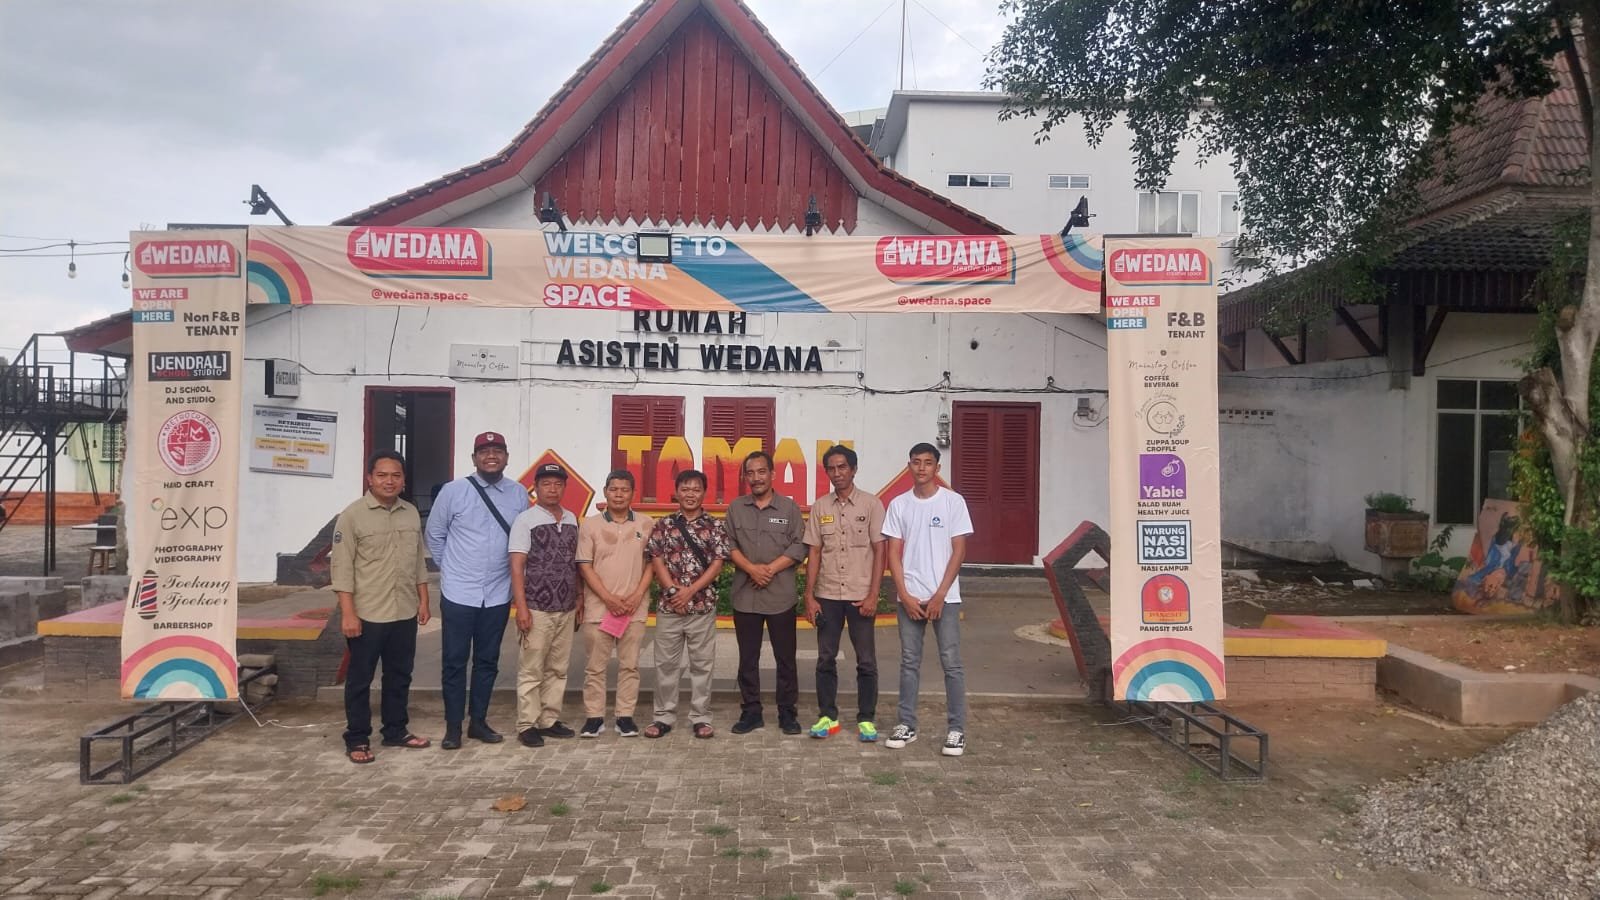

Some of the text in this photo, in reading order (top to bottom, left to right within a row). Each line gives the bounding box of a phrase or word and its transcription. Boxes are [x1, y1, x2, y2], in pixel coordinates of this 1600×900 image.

[371, 232, 478, 259] WEDANA
[545, 233, 727, 257] WELCOE TO
[151, 245, 231, 265] WEDANA
[898, 240, 1002, 265] WEDANA
[457, 259, 478, 267] space
[545, 257, 668, 280] WEDANA
[1125, 254, 1202, 272] WEDANA
[138, 289, 184, 299] WE ARE
[371, 288, 469, 302] @wedana.space
[545, 285, 632, 307] SPACE
[140, 300, 172, 310] OPEN
[897, 296, 992, 307] @wedana.space
[1111, 296, 1155, 306] WE ARE
[141, 311, 171, 321] HERE
[183, 311, 240, 323] Non F&B
[1112, 308, 1144, 317] OPEN
[634, 310, 747, 334] RUMAH
[1113, 319, 1143, 328] HERE
[1167, 312, 1206, 327] F&B
[185, 325, 240, 337] TENANT
[1168, 330, 1206, 339] TENANT
[557, 339, 823, 372] ASISTEN WEDANA
[193, 369, 222, 377] STUDIO
[179, 386, 211, 394] SCHOOL
[186, 396, 216, 404] STUDIO
[164, 412, 215, 431] METROCRAFT
[184, 480, 214, 488] CRAFT
[1143, 485, 1184, 498] Yabie
[161, 506, 228, 536] exp
[1144, 536, 1185, 546] NASI
[154, 545, 224, 553] PHOTOGRAPHY
[1144, 547, 1186, 558] RAOS
[154, 555, 222, 564] VIDEOGRAPHY
[162, 575, 231, 593] Toekang
[162, 592, 228, 611] Tjoekoer
[153, 622, 213, 630] BARBERSHOP
